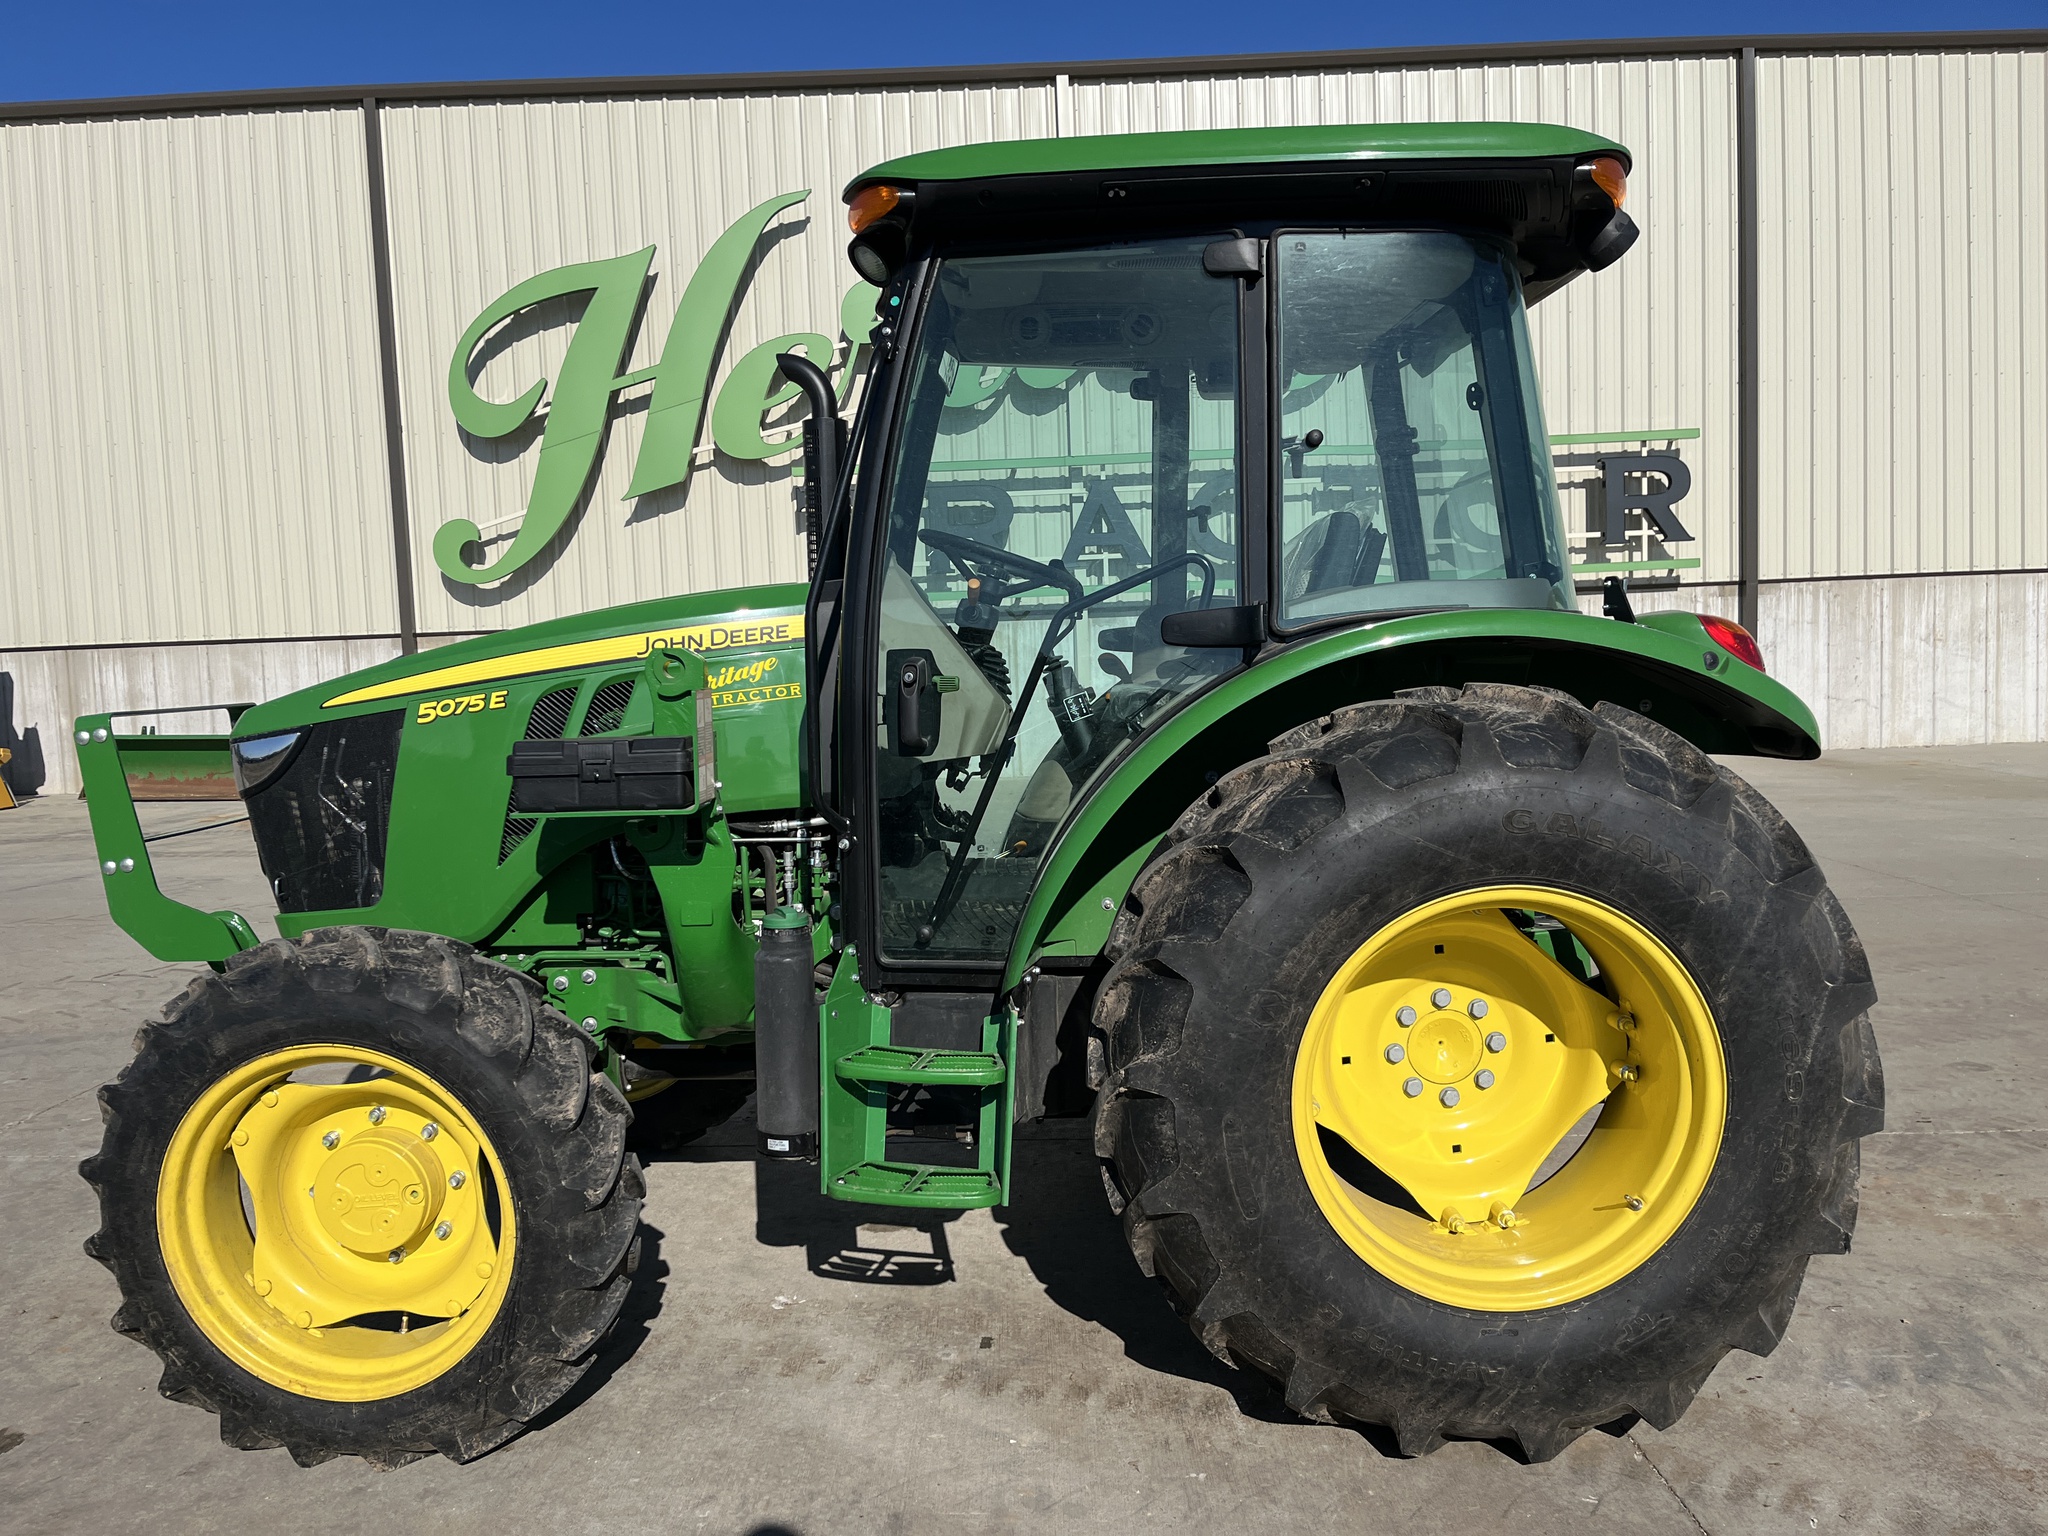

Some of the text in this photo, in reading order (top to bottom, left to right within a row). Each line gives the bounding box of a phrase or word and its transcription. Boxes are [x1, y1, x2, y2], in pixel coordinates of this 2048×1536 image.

[637, 624, 790, 656] JOHN DEERE
[707, 656, 778, 690] ritage
[711, 685, 802, 706] TRACTOR
[1501, 808, 1730, 905] GALAXY
